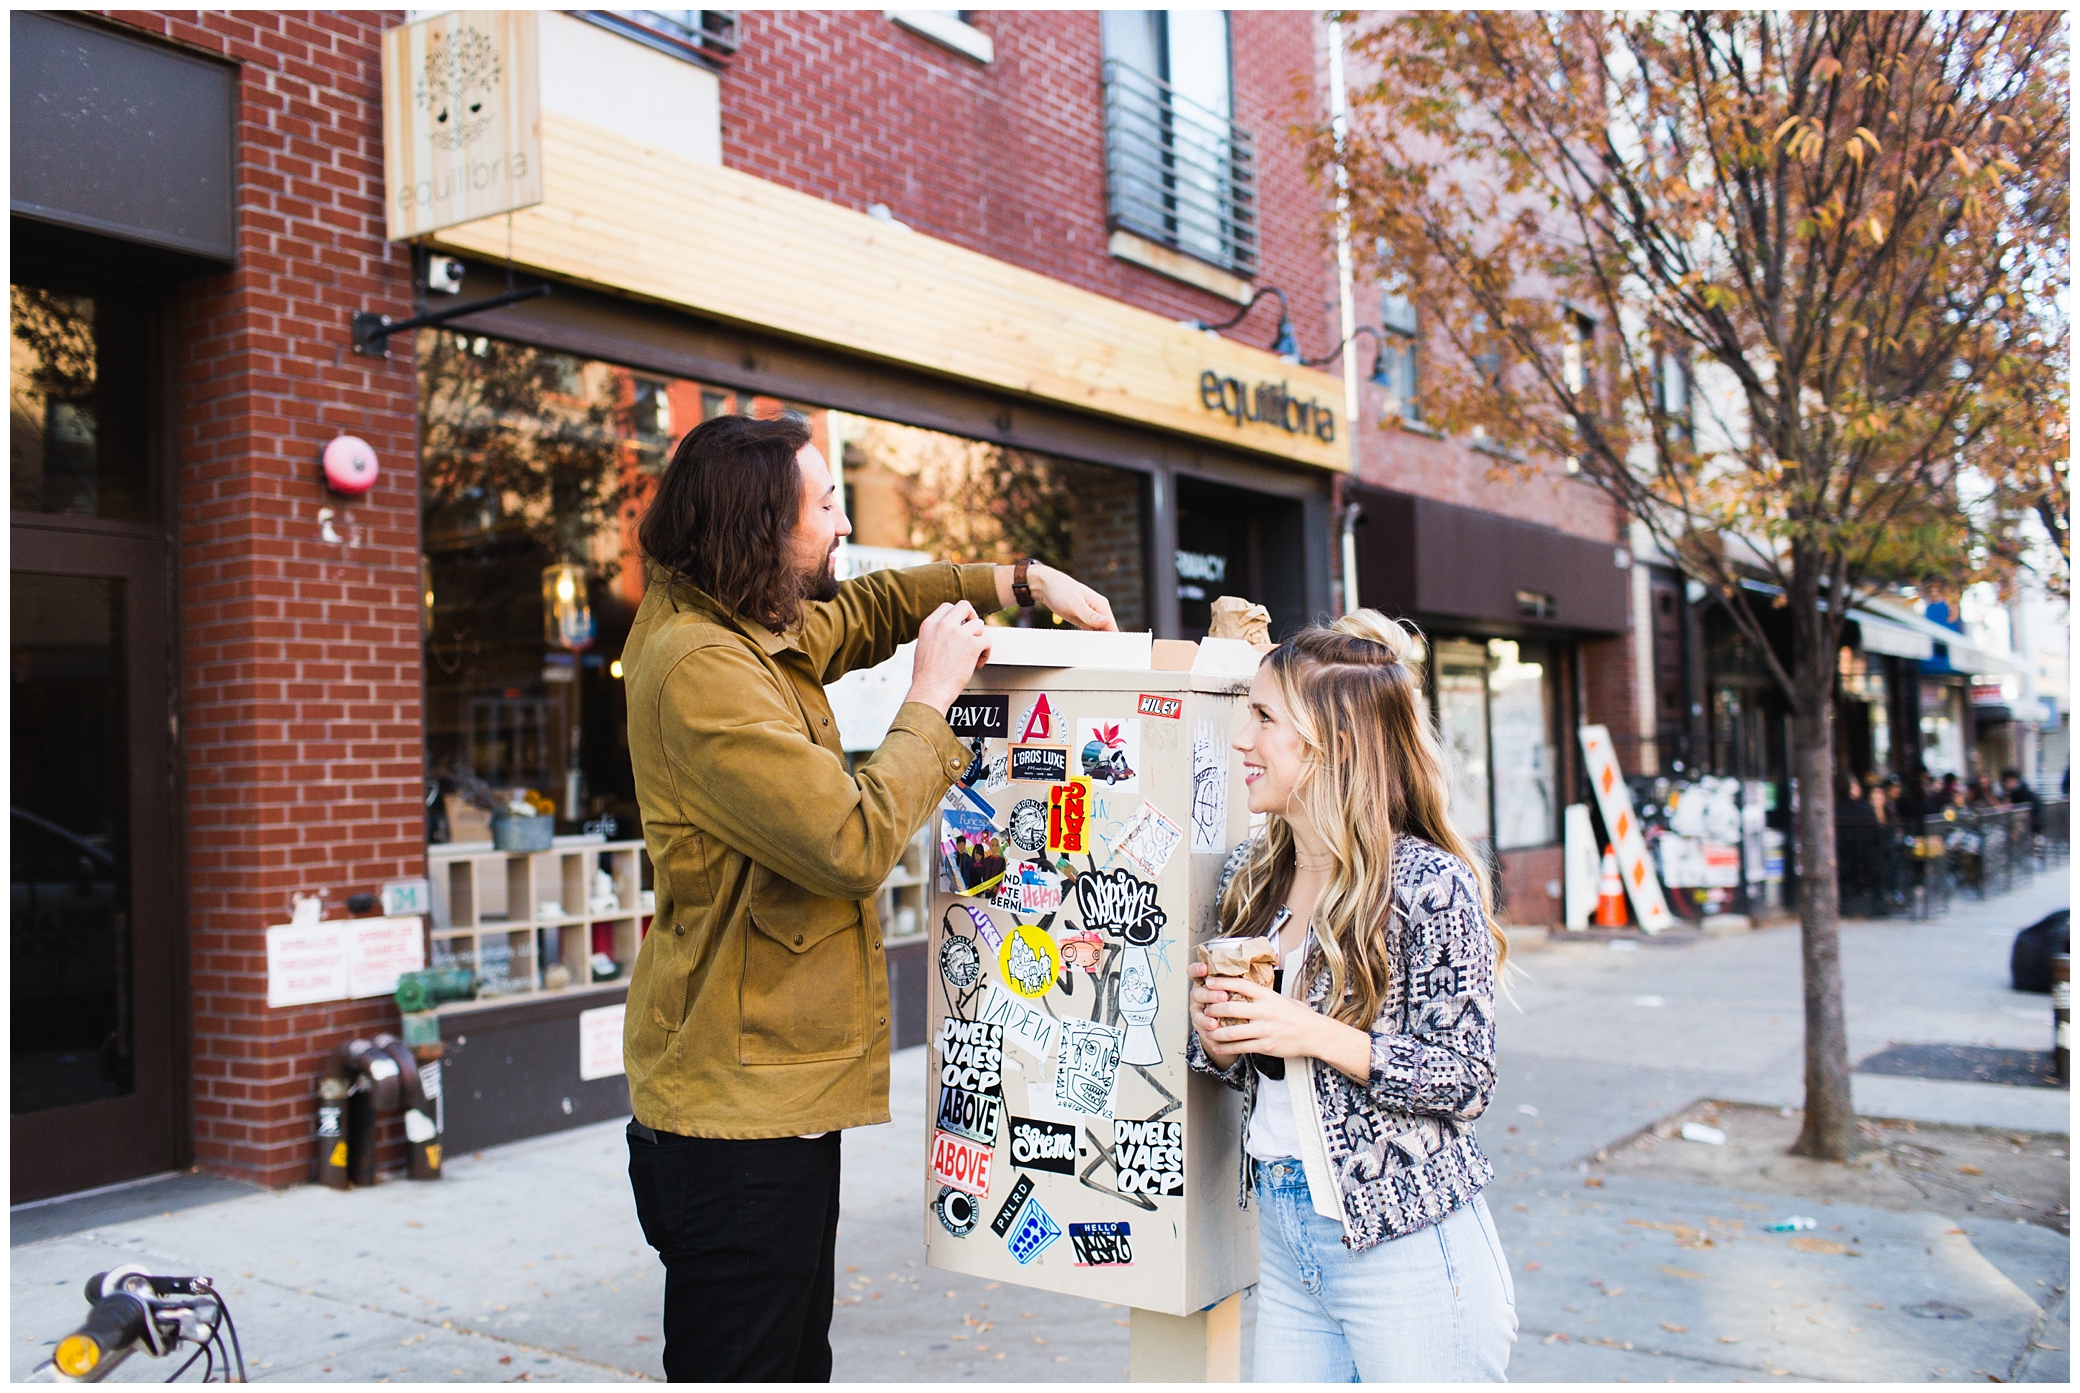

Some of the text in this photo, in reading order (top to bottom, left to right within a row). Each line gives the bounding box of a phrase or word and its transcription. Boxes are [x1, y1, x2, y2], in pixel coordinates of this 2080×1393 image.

[1200, 369, 1335, 443] equilibria
[1013, 750, 1065, 770] L'GROS LUXE
[1013, 799, 1047, 816] BROOKLYN
[942, 936, 975, 954] BROOKLYN
[943, 963, 980, 986] FISHING CLUB
[943, 1017, 1003, 1048] DWELS
[942, 1040, 1001, 1071] VAES
[942, 1064, 1001, 1093] OCP
[941, 1087, 997, 1138] ABOVE
[1114, 1120, 1182, 1147] DWELS
[935, 1139, 989, 1188] ABOVE
[1115, 1144, 1182, 1172] VAES
[1117, 1167, 1184, 1195] OCP
[997, 1182, 1028, 1229] PNLRD
[1084, 1223, 1117, 1232] HELLO
